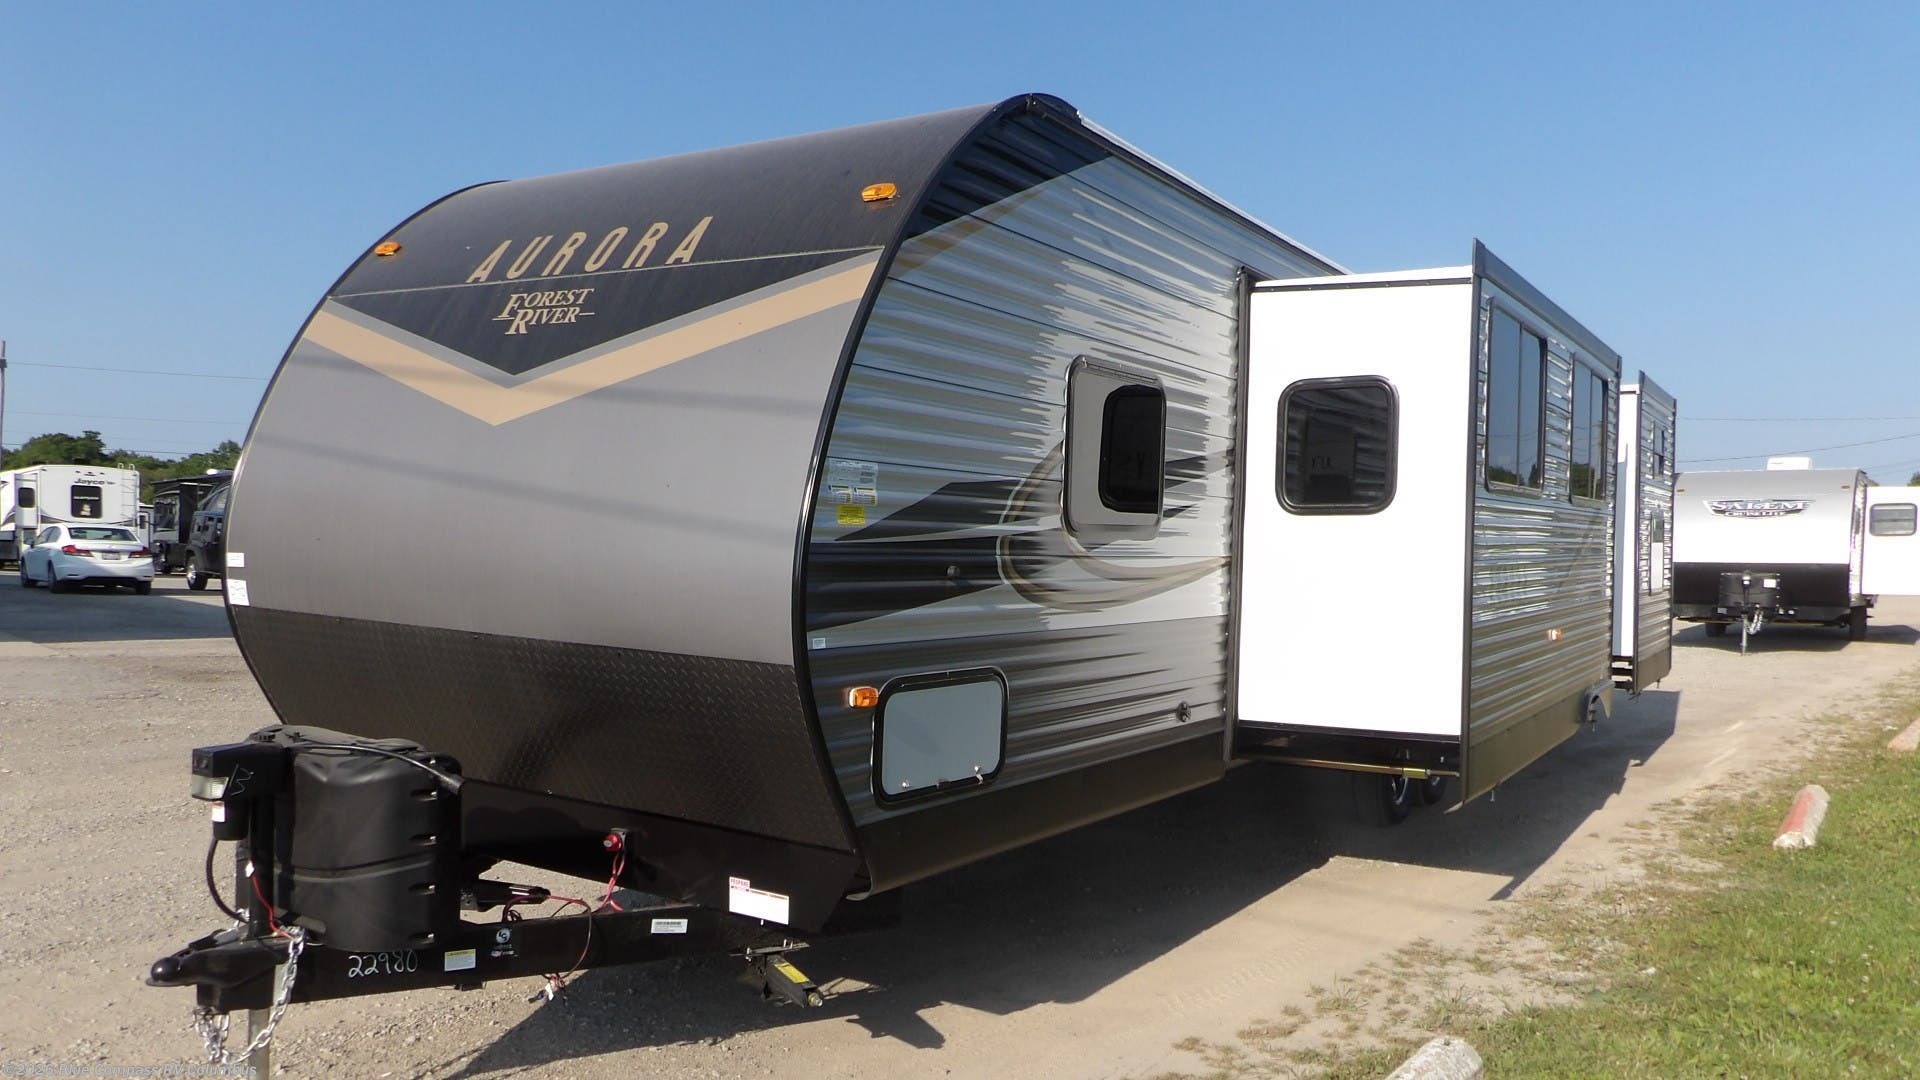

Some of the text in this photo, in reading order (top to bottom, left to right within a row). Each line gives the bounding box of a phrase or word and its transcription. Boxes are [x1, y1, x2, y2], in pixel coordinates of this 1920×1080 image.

[465, 215, 714, 284] AURORA
[497, 288, 595, 318] FOREST
[504, 306, 580, 335] RIVER
[1711, 501, 1808, 510] SALEM
[348, 949, 418, 978] 22980
